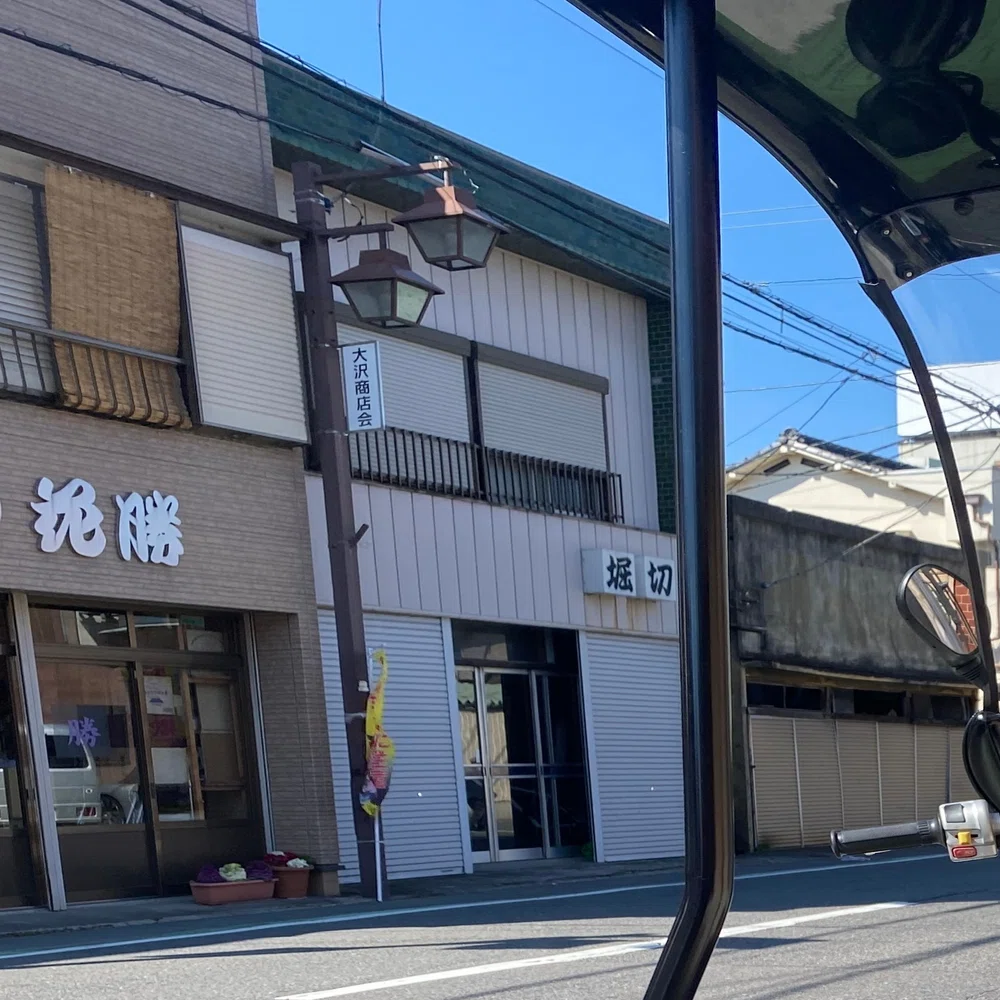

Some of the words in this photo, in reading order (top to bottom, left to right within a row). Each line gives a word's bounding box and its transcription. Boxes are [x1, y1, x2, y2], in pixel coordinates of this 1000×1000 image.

[352, 347, 372, 427] 大沢商店会
[606, 554, 673, 597] 堀切
